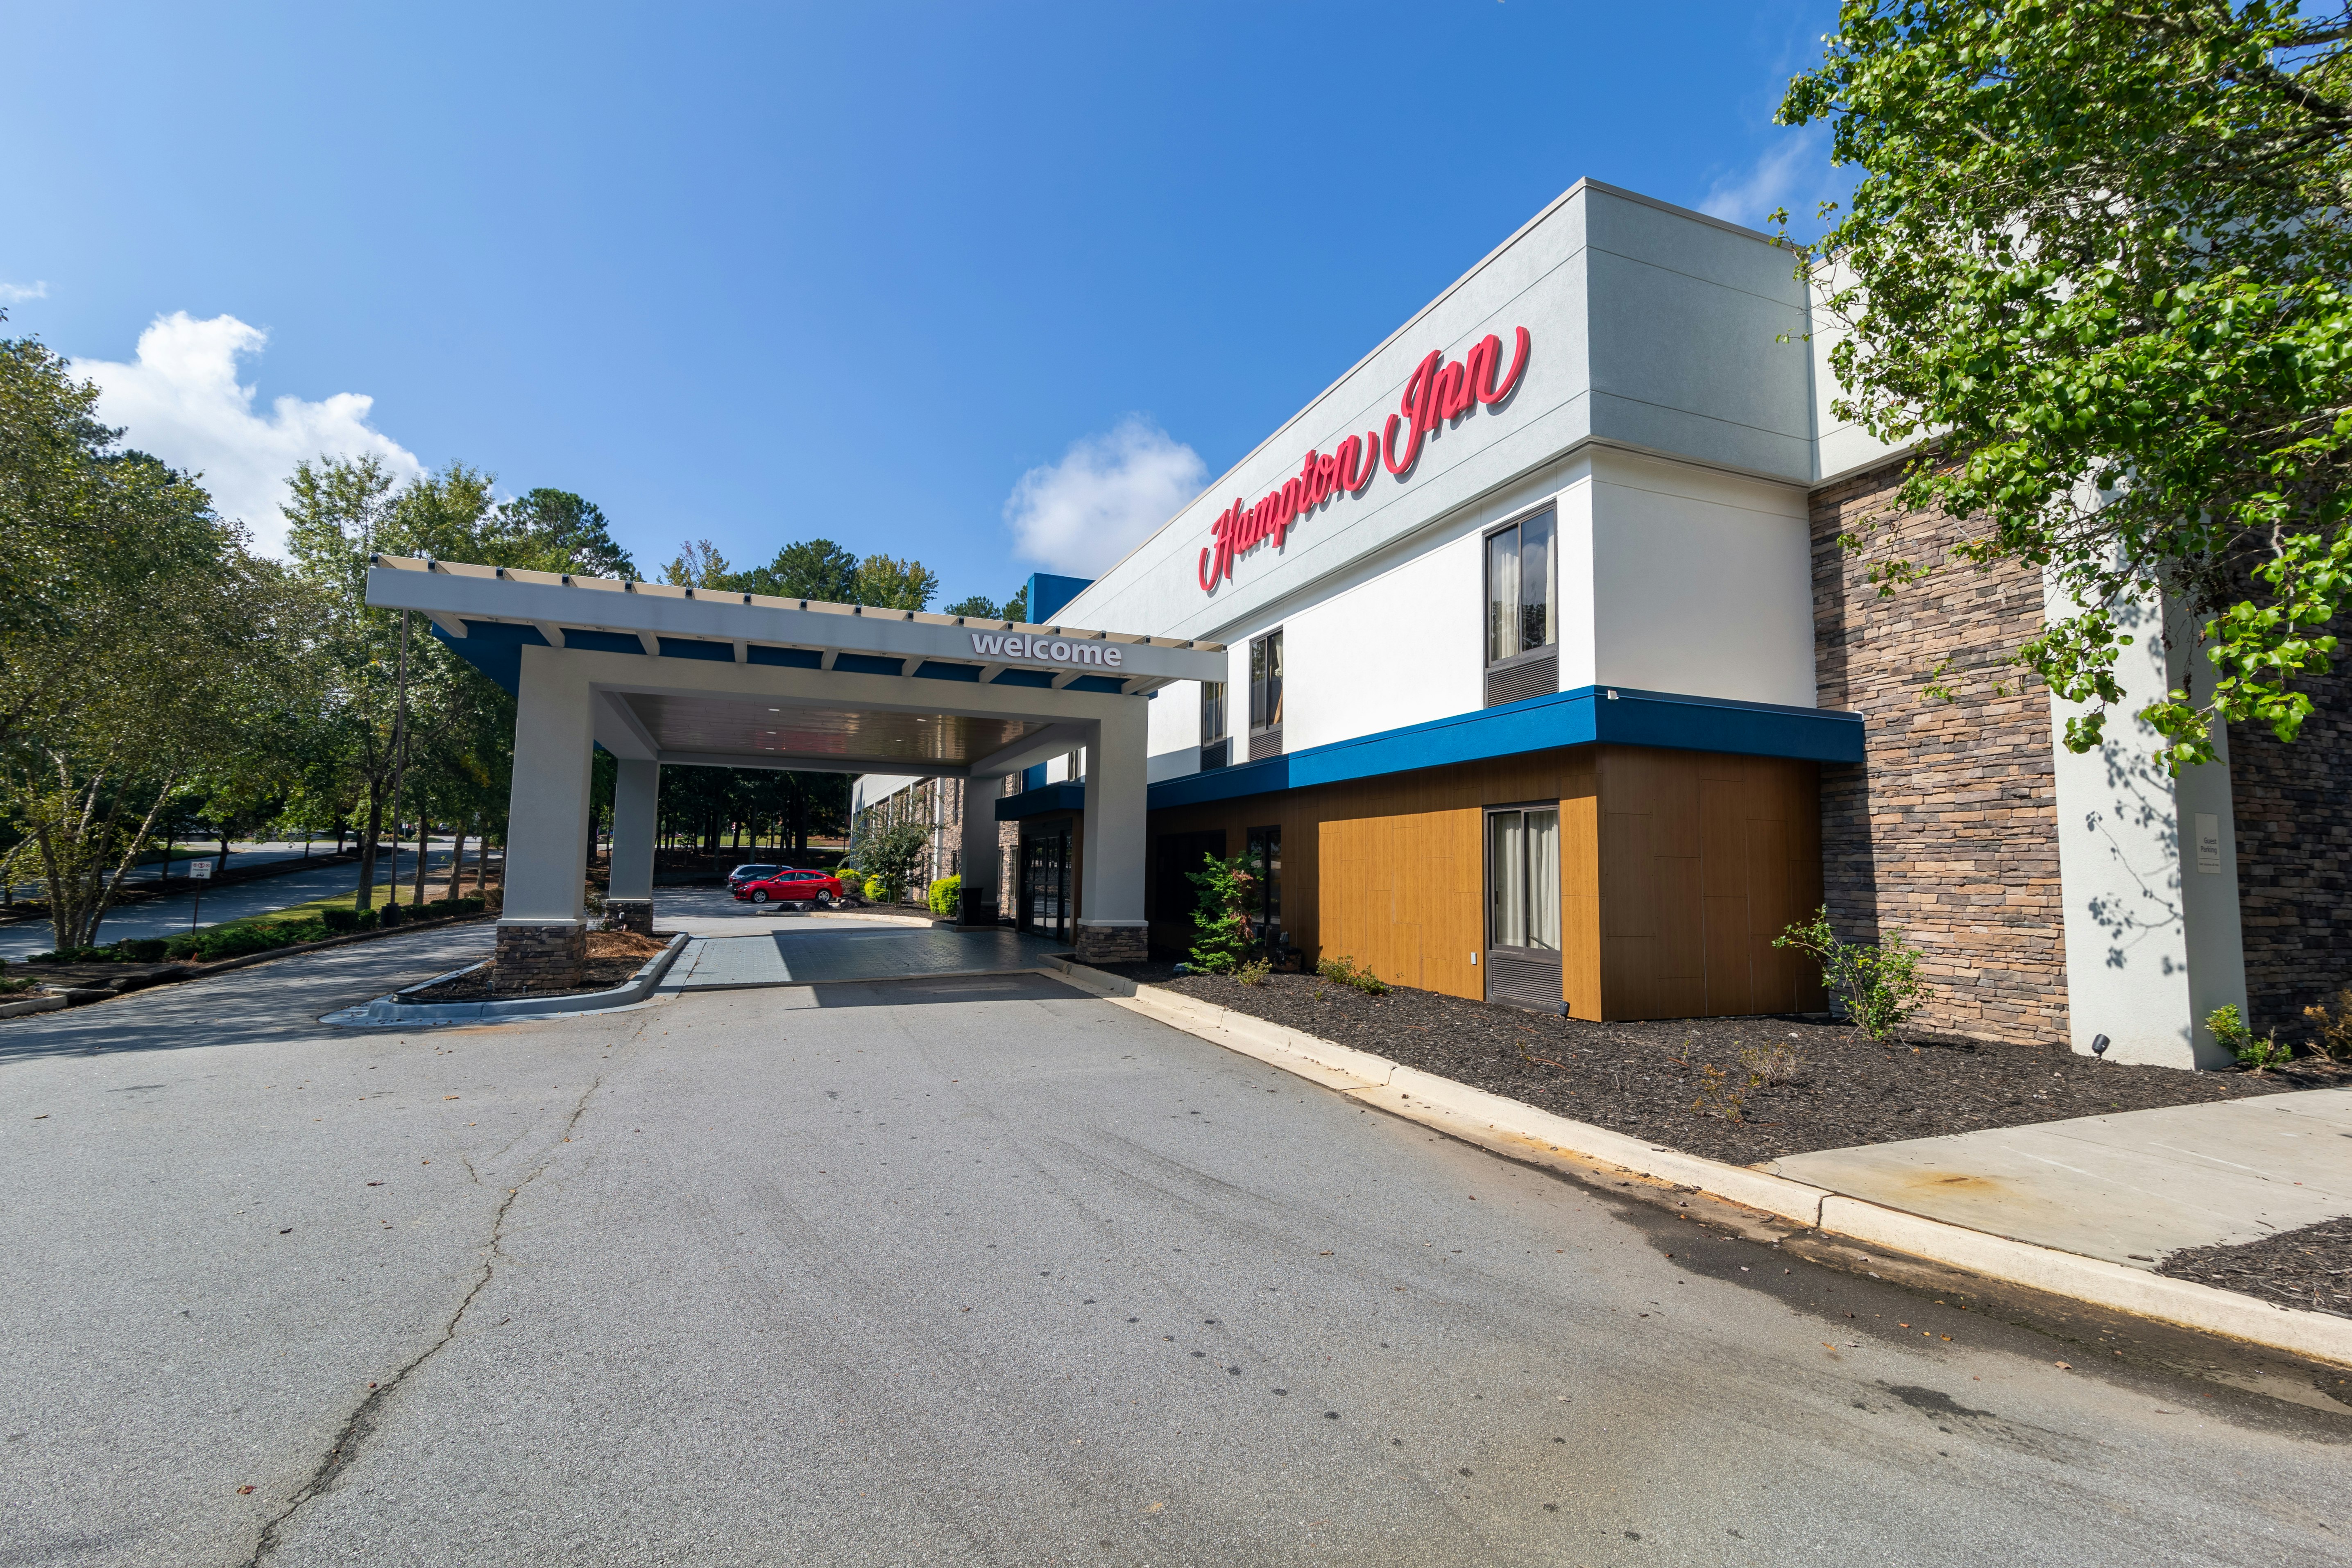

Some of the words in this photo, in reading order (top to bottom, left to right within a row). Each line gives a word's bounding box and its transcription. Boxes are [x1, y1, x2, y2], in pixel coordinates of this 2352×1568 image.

[1199, 431, 1378, 592] Hampton
[1382, 326, 1529, 474] Inn
[971, 633, 1122, 666] welcome
[2200, 846, 2217, 855] Parking
